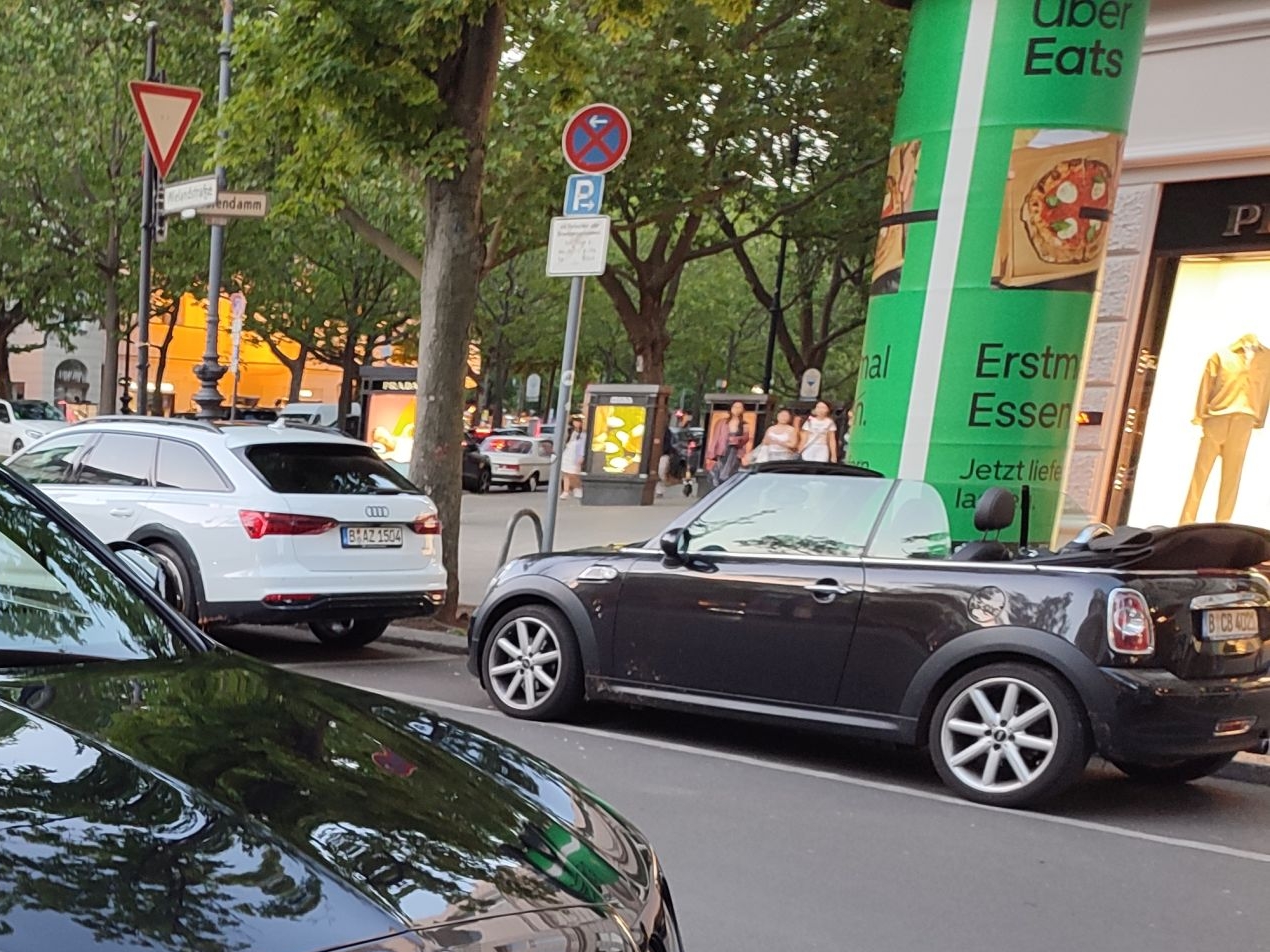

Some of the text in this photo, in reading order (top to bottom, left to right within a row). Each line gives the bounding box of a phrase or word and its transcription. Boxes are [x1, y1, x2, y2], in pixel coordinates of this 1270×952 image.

[1024, 37, 1123, 78] Eats
[217, 196, 262, 210] endamm
[572, 179, 594, 211] P
[959, 458, 1025, 481] Jetzt
[349, 530, 356, 543] B
[363, 530, 376, 543] AZ
